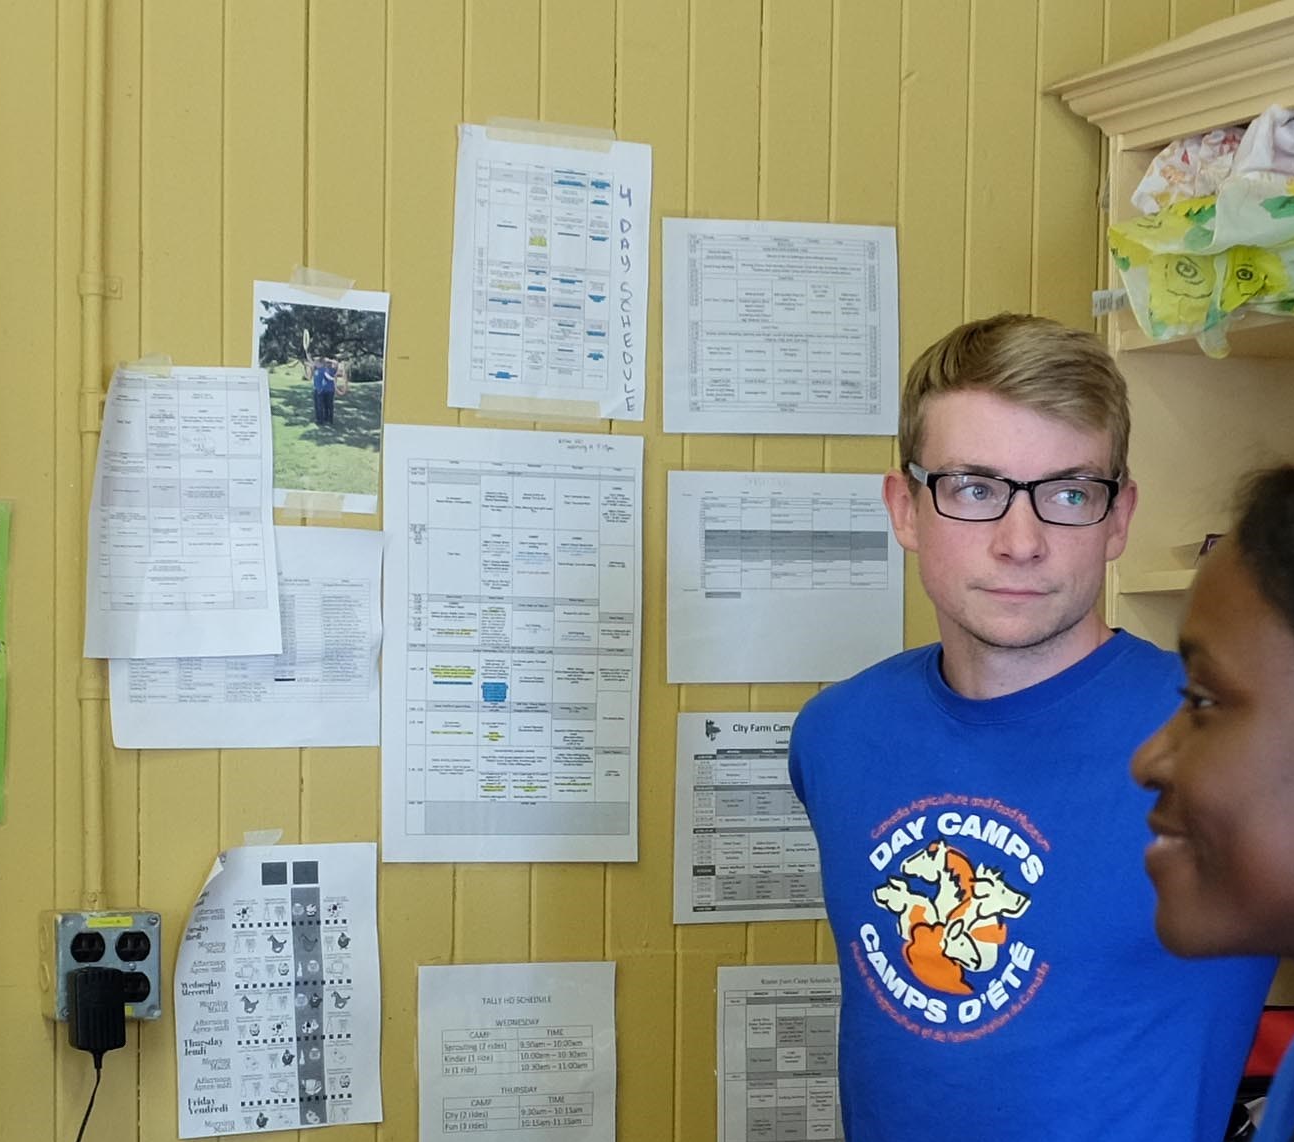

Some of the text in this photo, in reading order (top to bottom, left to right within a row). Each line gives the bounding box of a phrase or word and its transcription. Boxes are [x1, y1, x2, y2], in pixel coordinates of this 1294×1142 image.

[619, 184, 636, 412] 4 DAY SCHEDULE
[732, 723, 749, 735] City
[750, 723, 772, 733] Farm
[868, 815, 927, 872] DAY
[936, 812, 1045, 885] CAMPS
[859, 922, 1035, 1024] CAMPS D'ÉTÉ
[482, 997, 502, 1005] TALLY
[516, 995, 552, 1004] SCHEDULE
[495, 1018, 539, 1027] WEDNESDAY
[469, 1031, 491, 1040] CAMP
[546, 1028, 564, 1036] TIME
[501, 1086, 537, 1095] THURSDAY
[187, 1096, 216, 1107] Friday
[470, 1098, 492, 1107] CAMP
[548, 1095, 565, 1103] TIME
[188, 1103, 228, 1115] Vendredi
